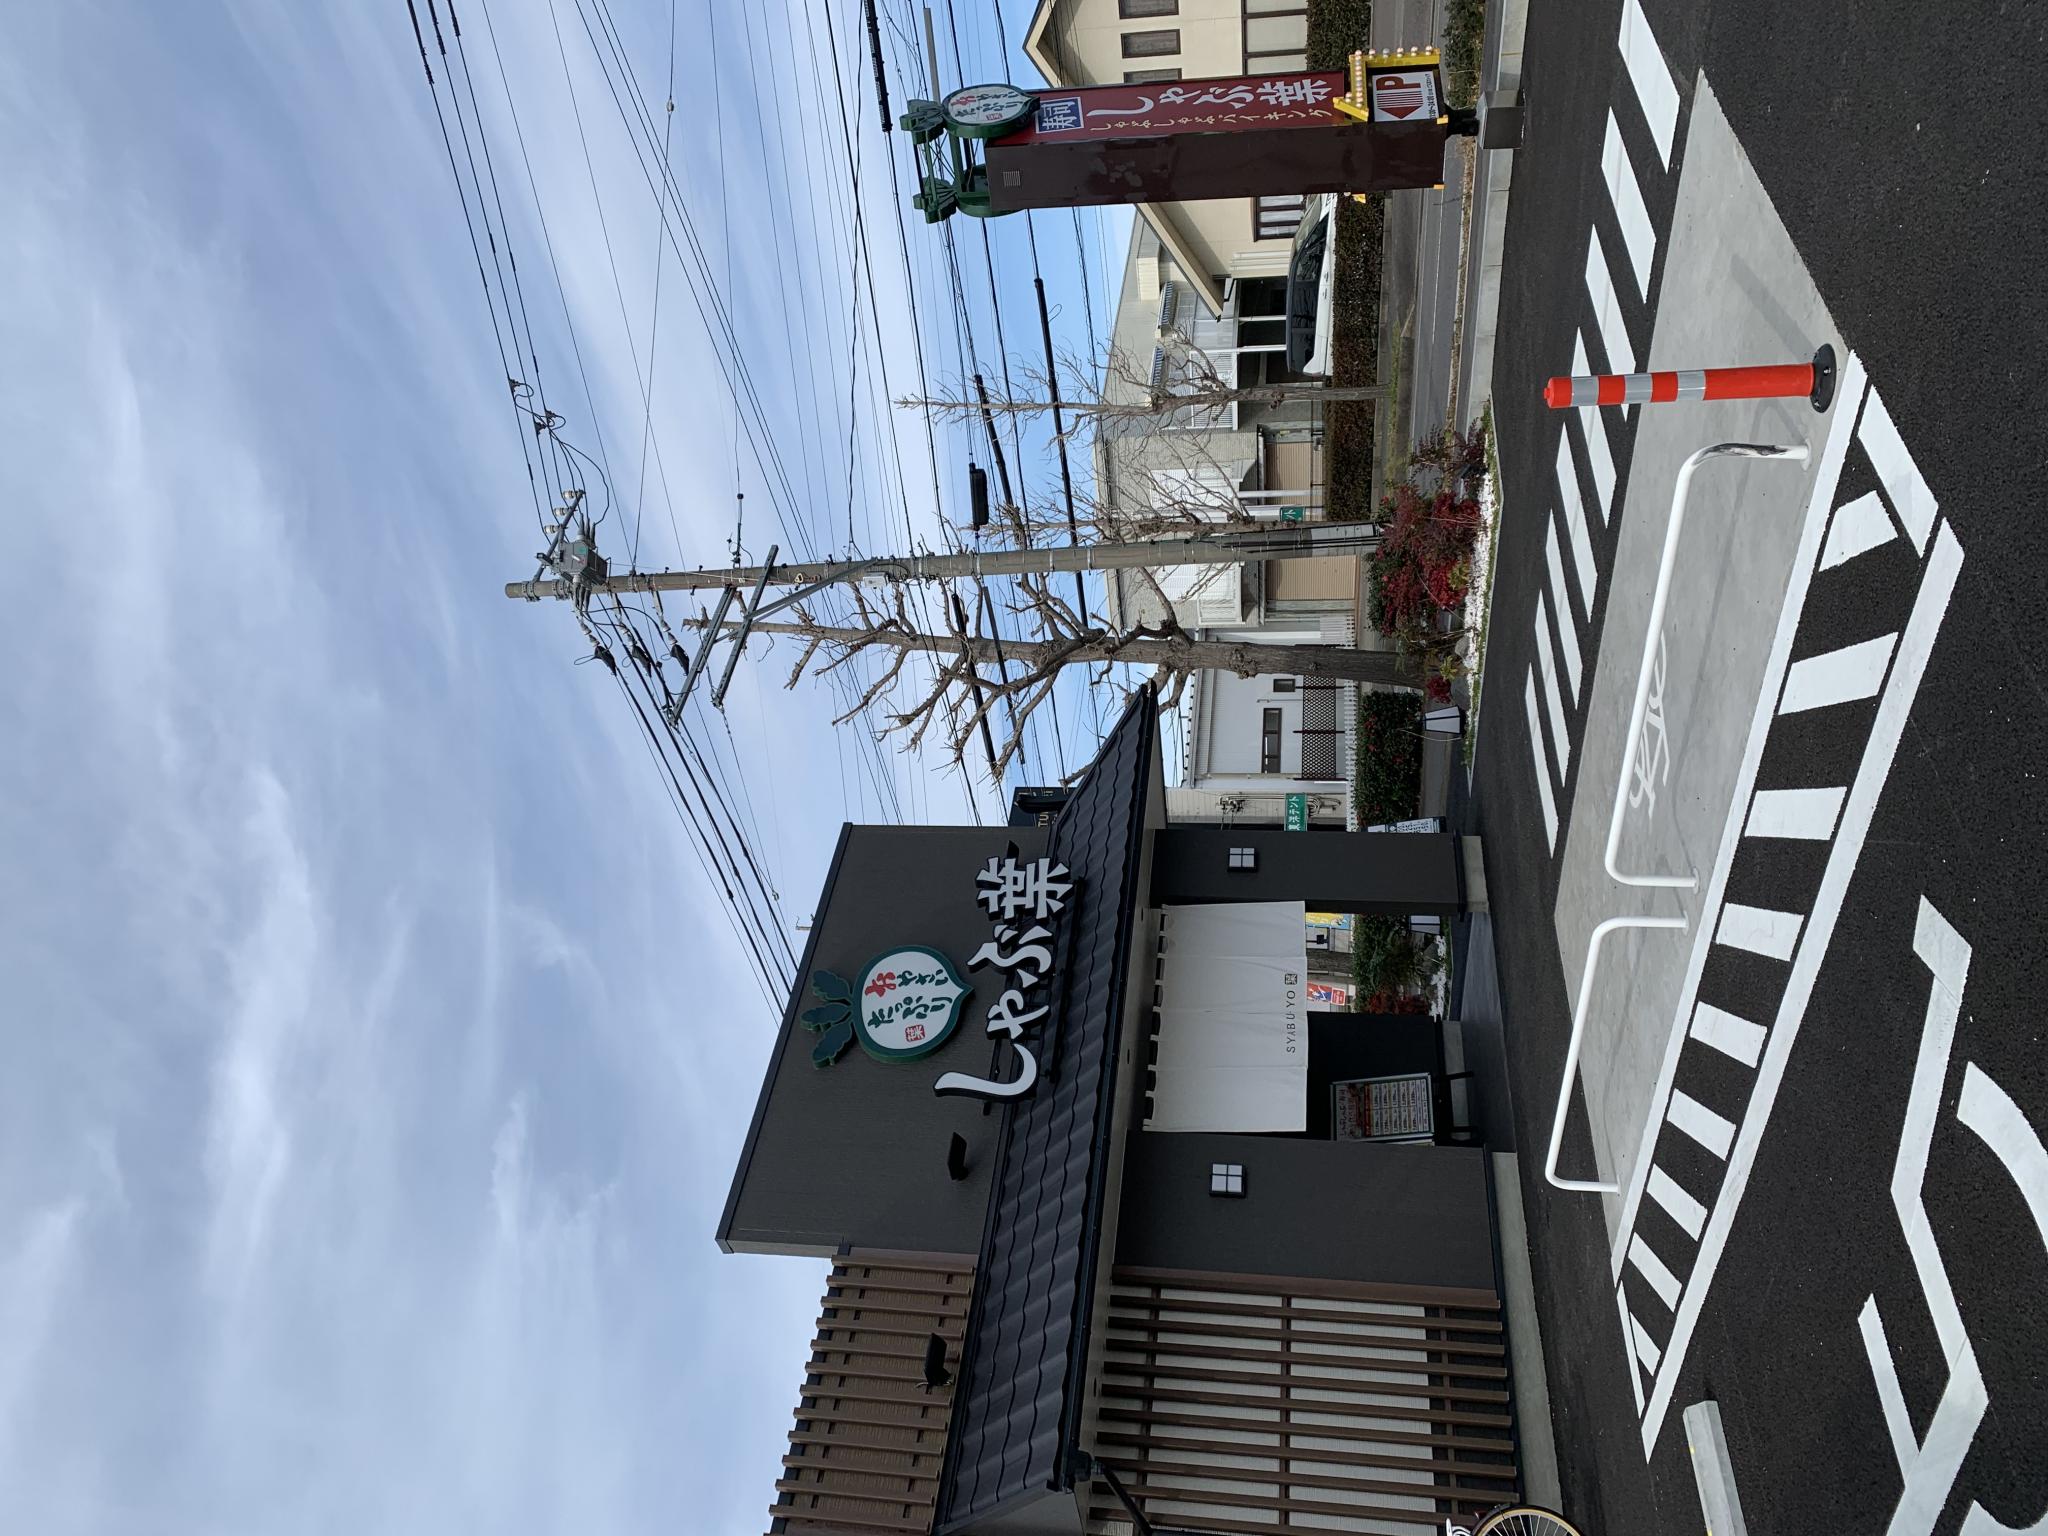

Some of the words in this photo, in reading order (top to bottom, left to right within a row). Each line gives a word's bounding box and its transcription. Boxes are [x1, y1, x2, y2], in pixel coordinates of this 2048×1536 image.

[1085, 78, 1333, 118] しゃぶ葉
[1375, 76, 1422, 91] P
[1040, 101, 1077, 130] 寿司
[1089, 107, 1333, 131] しゃぶしゃぶバイキング
[864, 969, 948, 998] おやさい
[933, 856, 1073, 1098] しゃぶ葉
[867, 996, 952, 1029] たっぷり
